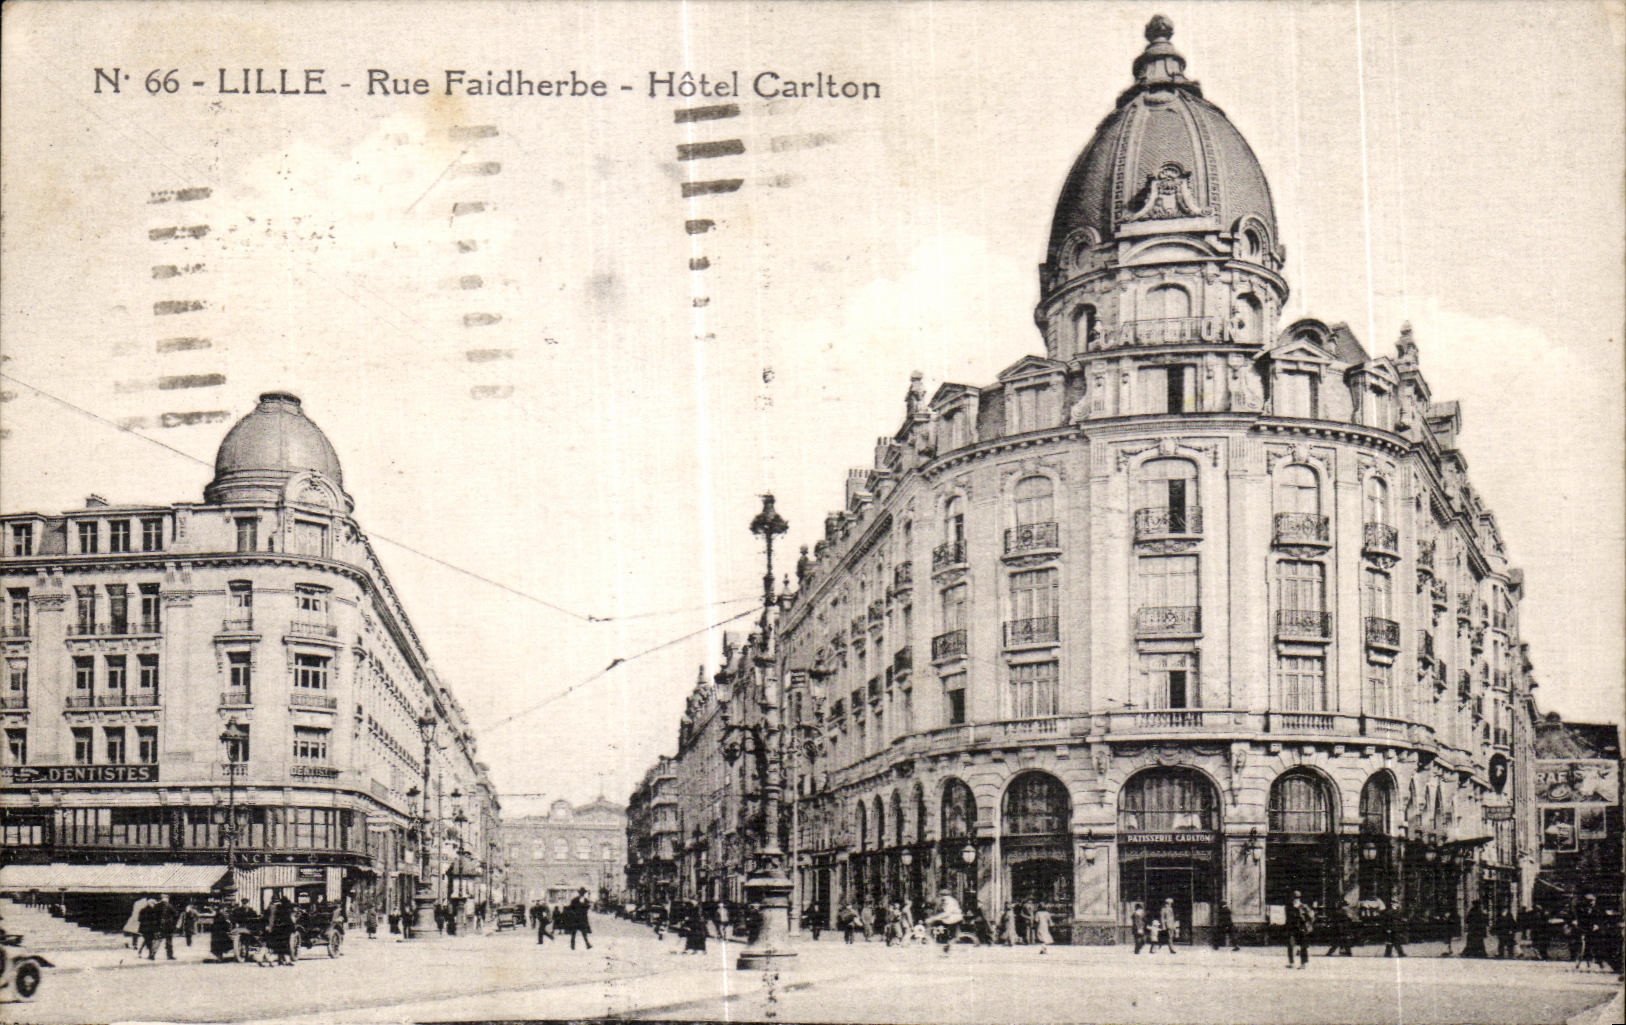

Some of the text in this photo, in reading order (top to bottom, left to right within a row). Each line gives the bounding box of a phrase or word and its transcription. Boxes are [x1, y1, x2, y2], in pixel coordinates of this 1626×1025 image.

[50, 767, 150, 782] DENTISTES
[1127, 834, 1211, 843] PATISSERIE CARLTON
